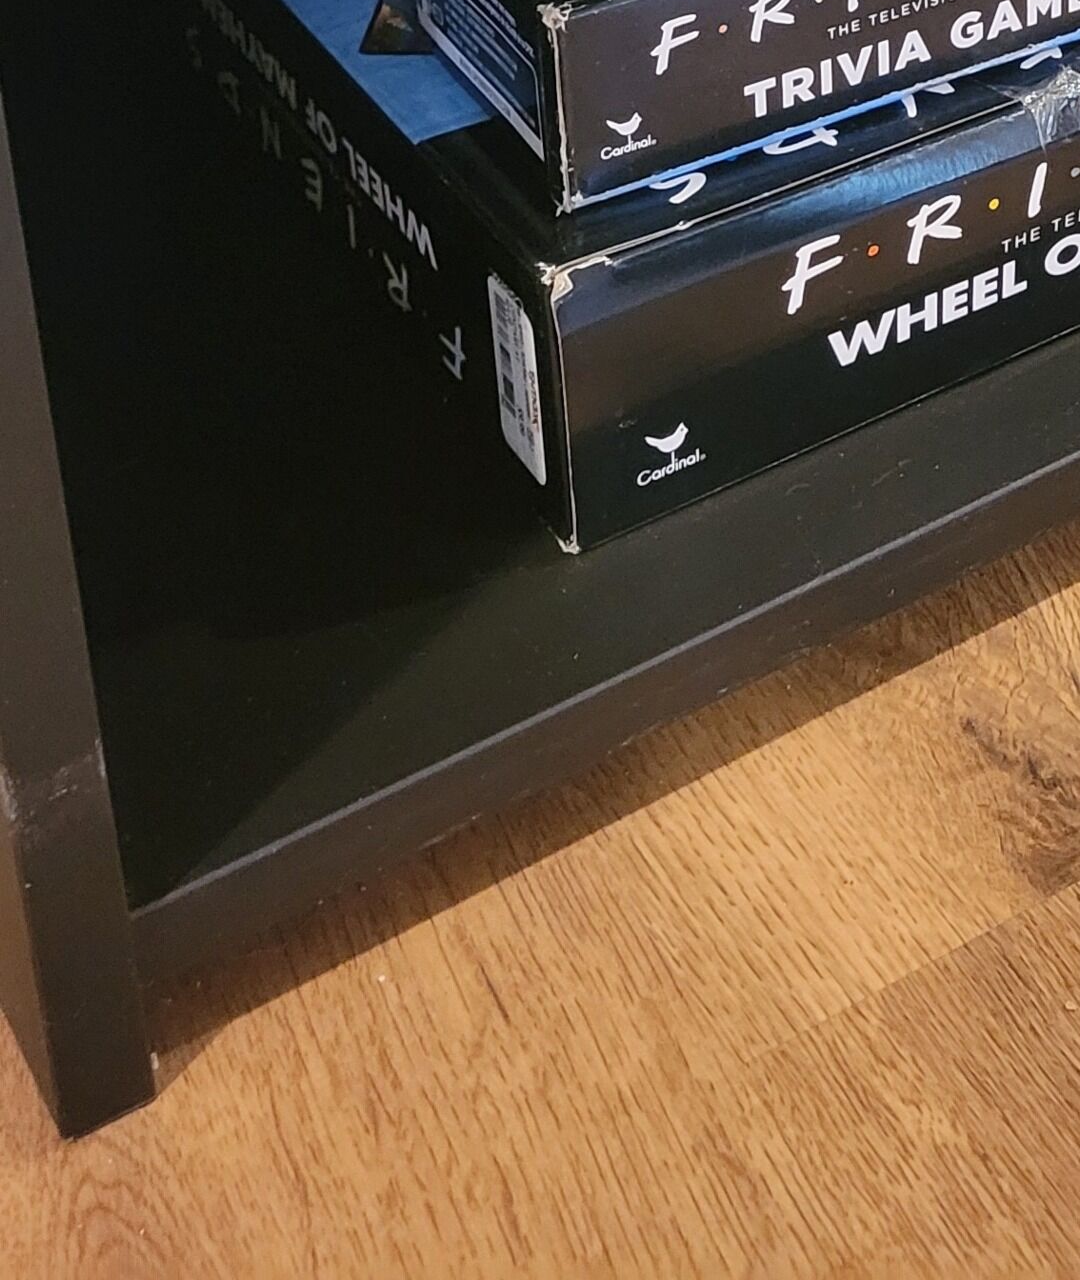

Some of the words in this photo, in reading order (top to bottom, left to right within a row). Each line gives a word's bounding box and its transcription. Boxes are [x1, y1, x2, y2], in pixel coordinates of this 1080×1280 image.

[827, 19, 863, 40] THE
[743, 27, 932, 118] TRIVIA
[306, 99, 339, 151] OF
[600, 133, 656, 161] Cardinal
[343, 137, 439, 272] WHEEL
[1001, 227, 1042, 252] THE
[828, 271, 1028, 367] WHEEL
[636, 447, 701, 487] Cardinal
